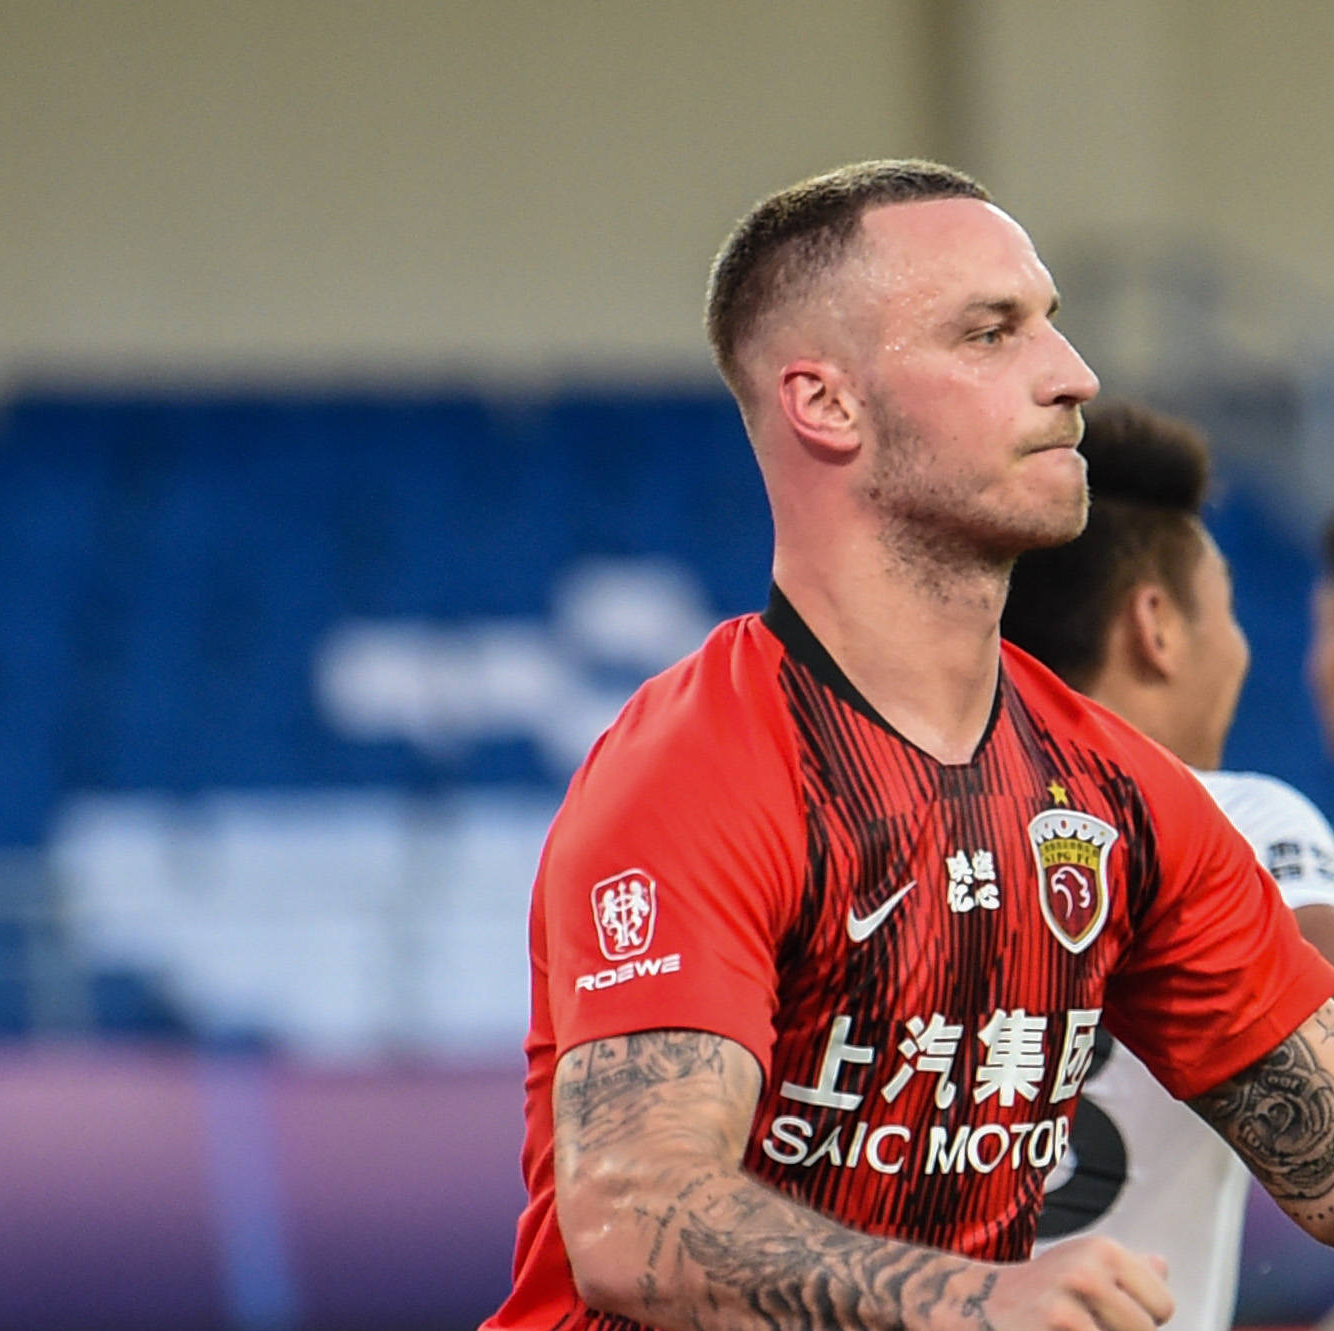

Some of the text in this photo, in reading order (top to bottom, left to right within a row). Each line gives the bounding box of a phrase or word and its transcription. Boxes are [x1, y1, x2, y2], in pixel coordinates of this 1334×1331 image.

[575, 953, 681, 992] ROEWE
[779, 1008, 1103, 1111] 上汽集团
[762, 1114, 911, 1174] SAIC
